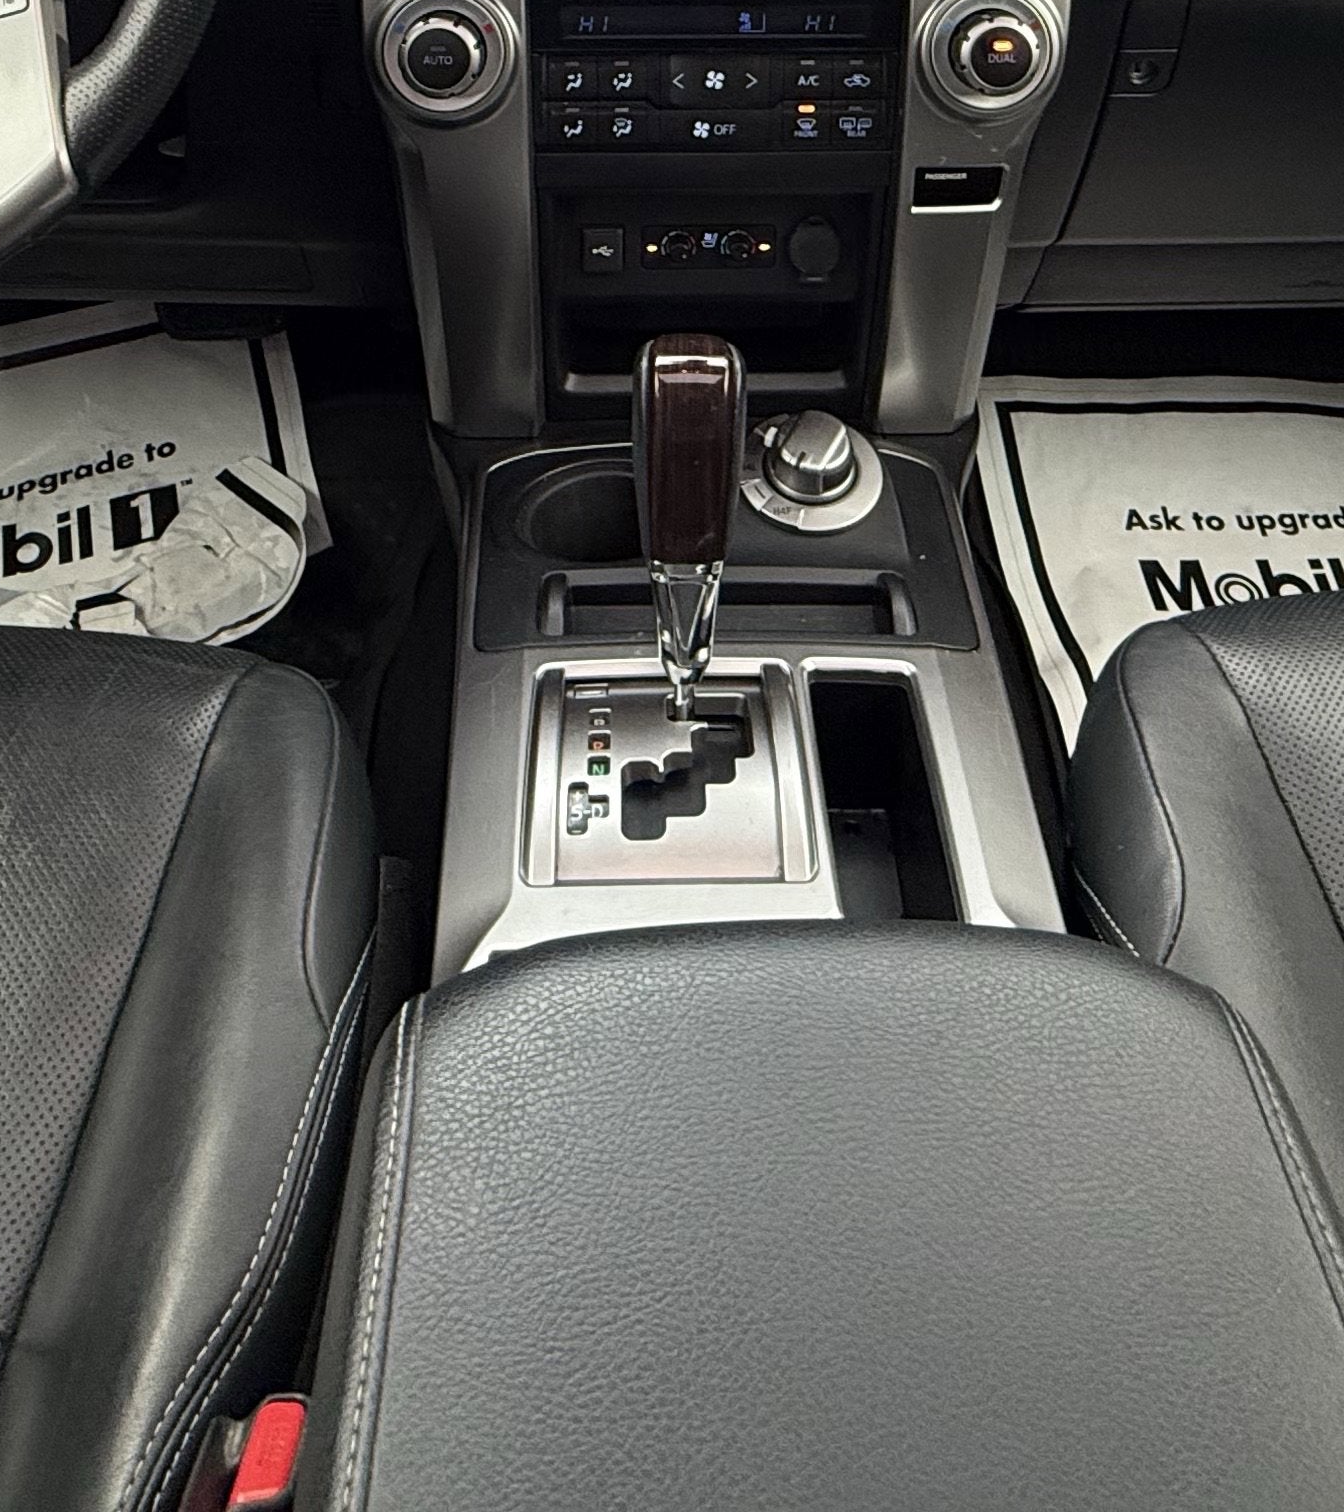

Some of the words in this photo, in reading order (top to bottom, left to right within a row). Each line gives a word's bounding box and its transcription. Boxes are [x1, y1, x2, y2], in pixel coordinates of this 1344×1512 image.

[423, 55, 453, 65] AUTO
[987, 52, 1016, 64] DUAL
[797, 74, 820, 87] A/C
[713, 123, 737, 136] OFF
[793, 129, 819, 138] FRONT
[924, 171, 968, 180] PASSENGER
[144, 440, 177, 462] to
[1124, 505, 1184, 533] Ask
[1192, 510, 1226, 532] to
[591, 764, 606, 776] N
